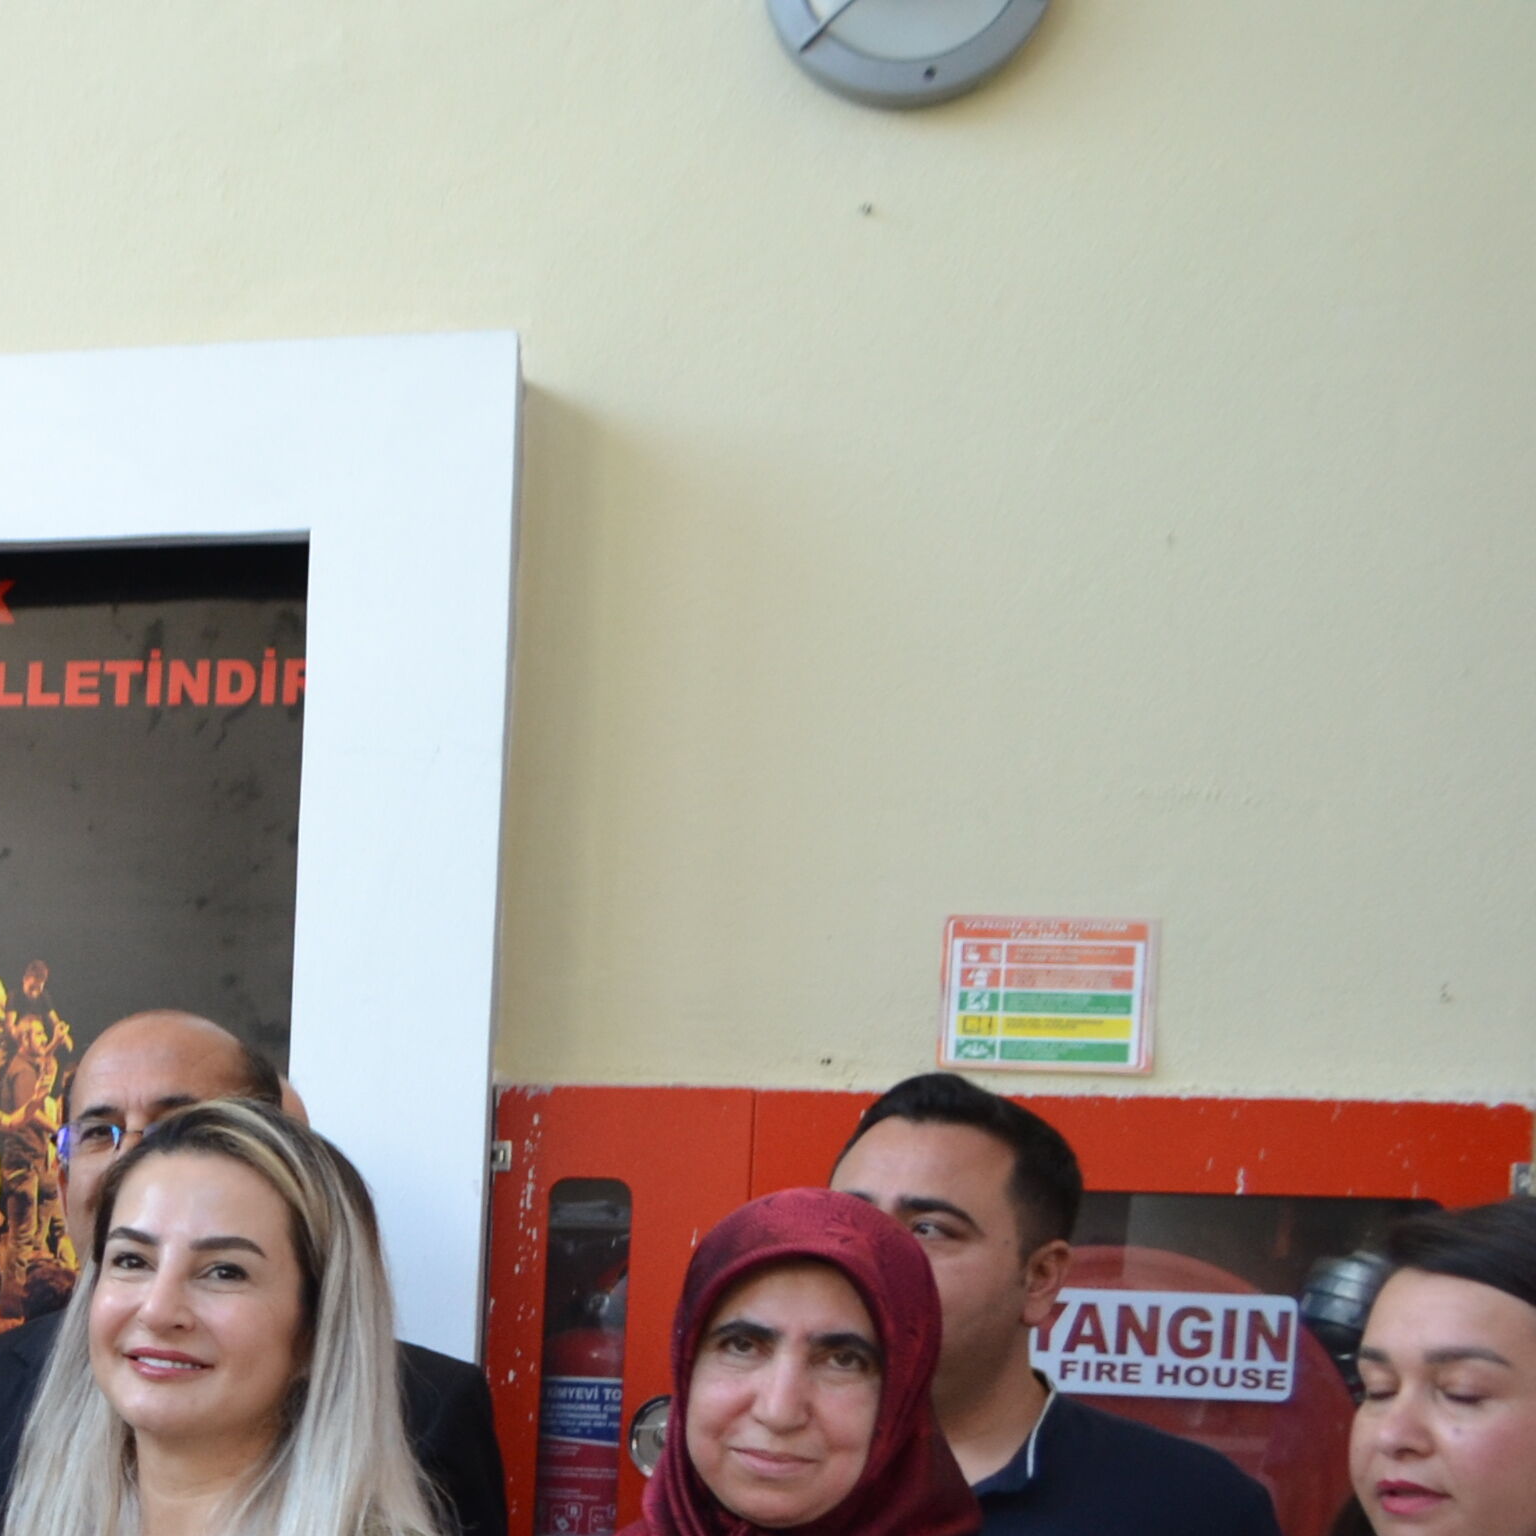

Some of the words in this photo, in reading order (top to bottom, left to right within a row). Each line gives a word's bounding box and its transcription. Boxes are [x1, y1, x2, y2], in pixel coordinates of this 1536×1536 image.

[1035, 1302, 1292, 1363] YANGIN
[1059, 1359, 1142, 1385] FIRE
[1156, 1363, 1288, 1391] HOUSE
